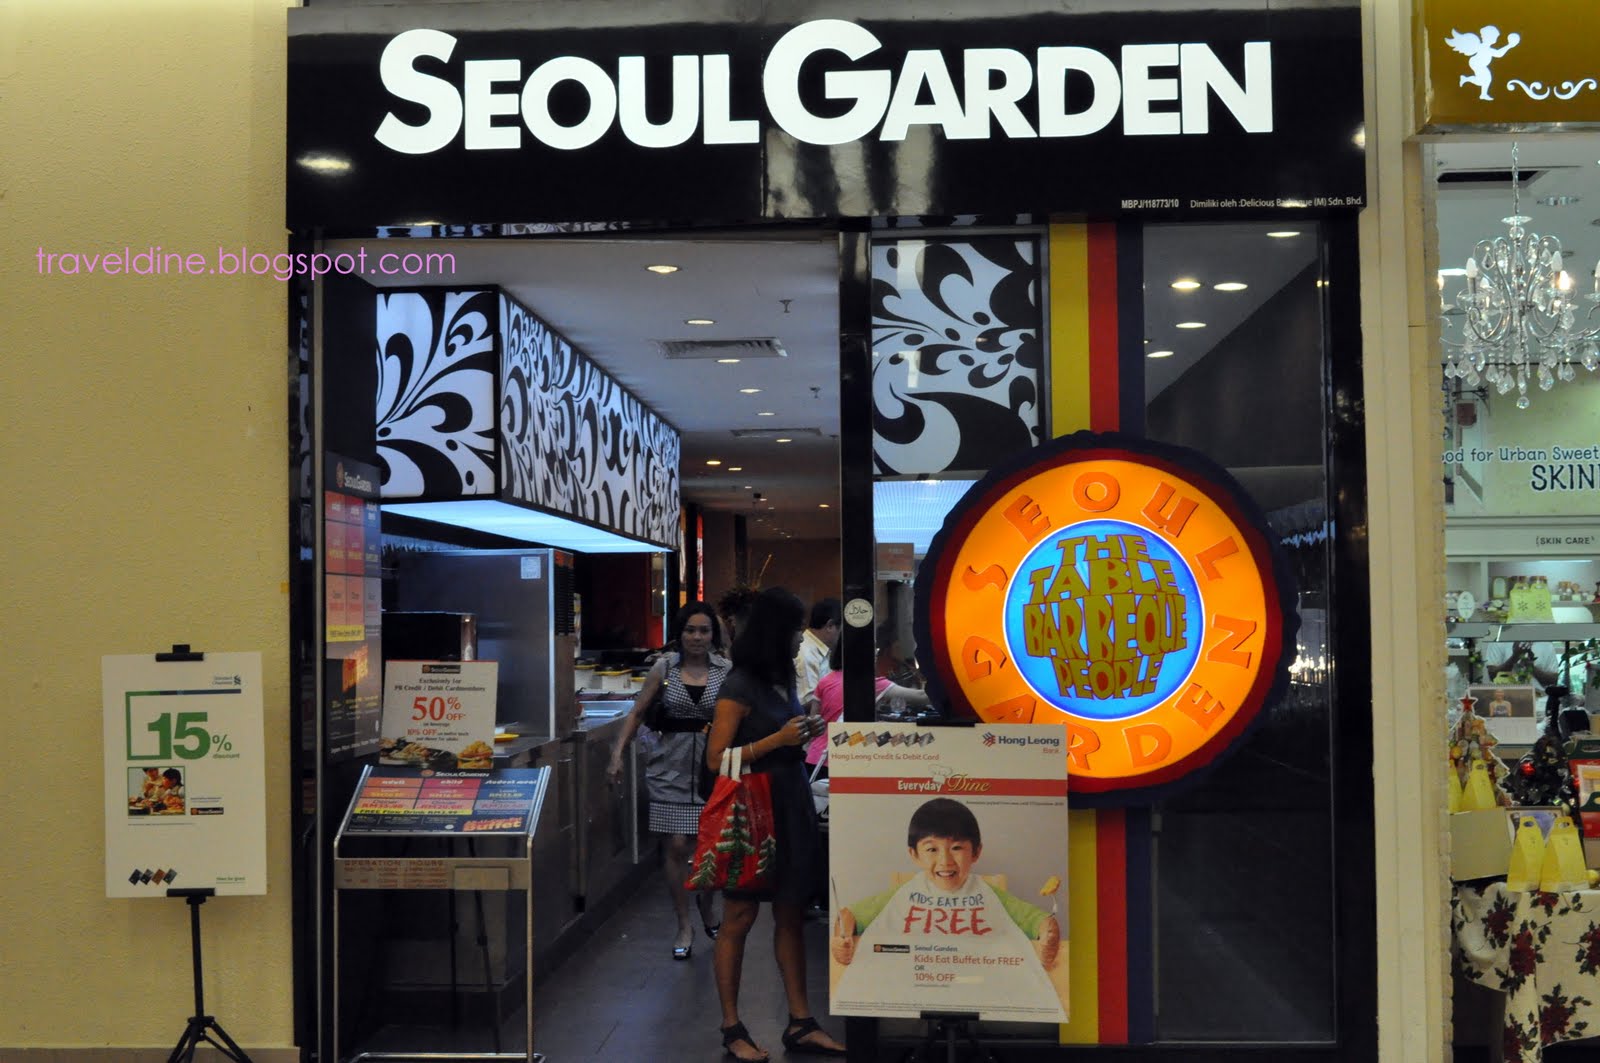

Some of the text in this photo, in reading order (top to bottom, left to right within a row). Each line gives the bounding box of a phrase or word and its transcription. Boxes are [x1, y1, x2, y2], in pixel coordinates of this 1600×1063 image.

[374, 19, 1274, 154] SEOUL GARDEN
[1121, 199, 1179, 209] MBPJ/118773/10
[1190, 199, 1219, 208] Dimiliki
[1220, 198, 1237, 208] oleh
[1314, 197, 1327, 207] (M)
[1328, 197, 1345, 206] Sdn.
[1346, 196, 1364, 206] Bhd.
[1471, 448, 1493, 462] for
[1499, 447, 1547, 461] Urban
[1531, 464, 1600, 491] SKIN
[961, 471, 1240, 592] SEOUL
[1057, 534, 1150, 566] THE
[1027, 557, 1180, 604] TABLE
[1022, 591, 1188, 662] BARBEQUE
[1051, 653, 1165, 700] PEOPLE
[961, 613, 1257, 772] GARDEN
[998, 735, 1060, 747] Hong Leong
[831, 753, 851, 761] Hong
[851, 753, 872, 762] Leong
[873, 753, 894, 761] Credit
[923, 754, 940, 762] Card
[898, 774, 992, 793] Everyday Dine
[909, 892, 985, 907] KIDS EAT FOR
[904, 905, 993, 936] FREE
[914, 954, 934, 964] Kids
[935, 955, 951, 964] Eat
[952, 955, 981, 965] Buffet
[982, 956, 996, 965] for
[933, 945, 958, 953] Garden
[914, 973, 956, 982] 10% OFF
